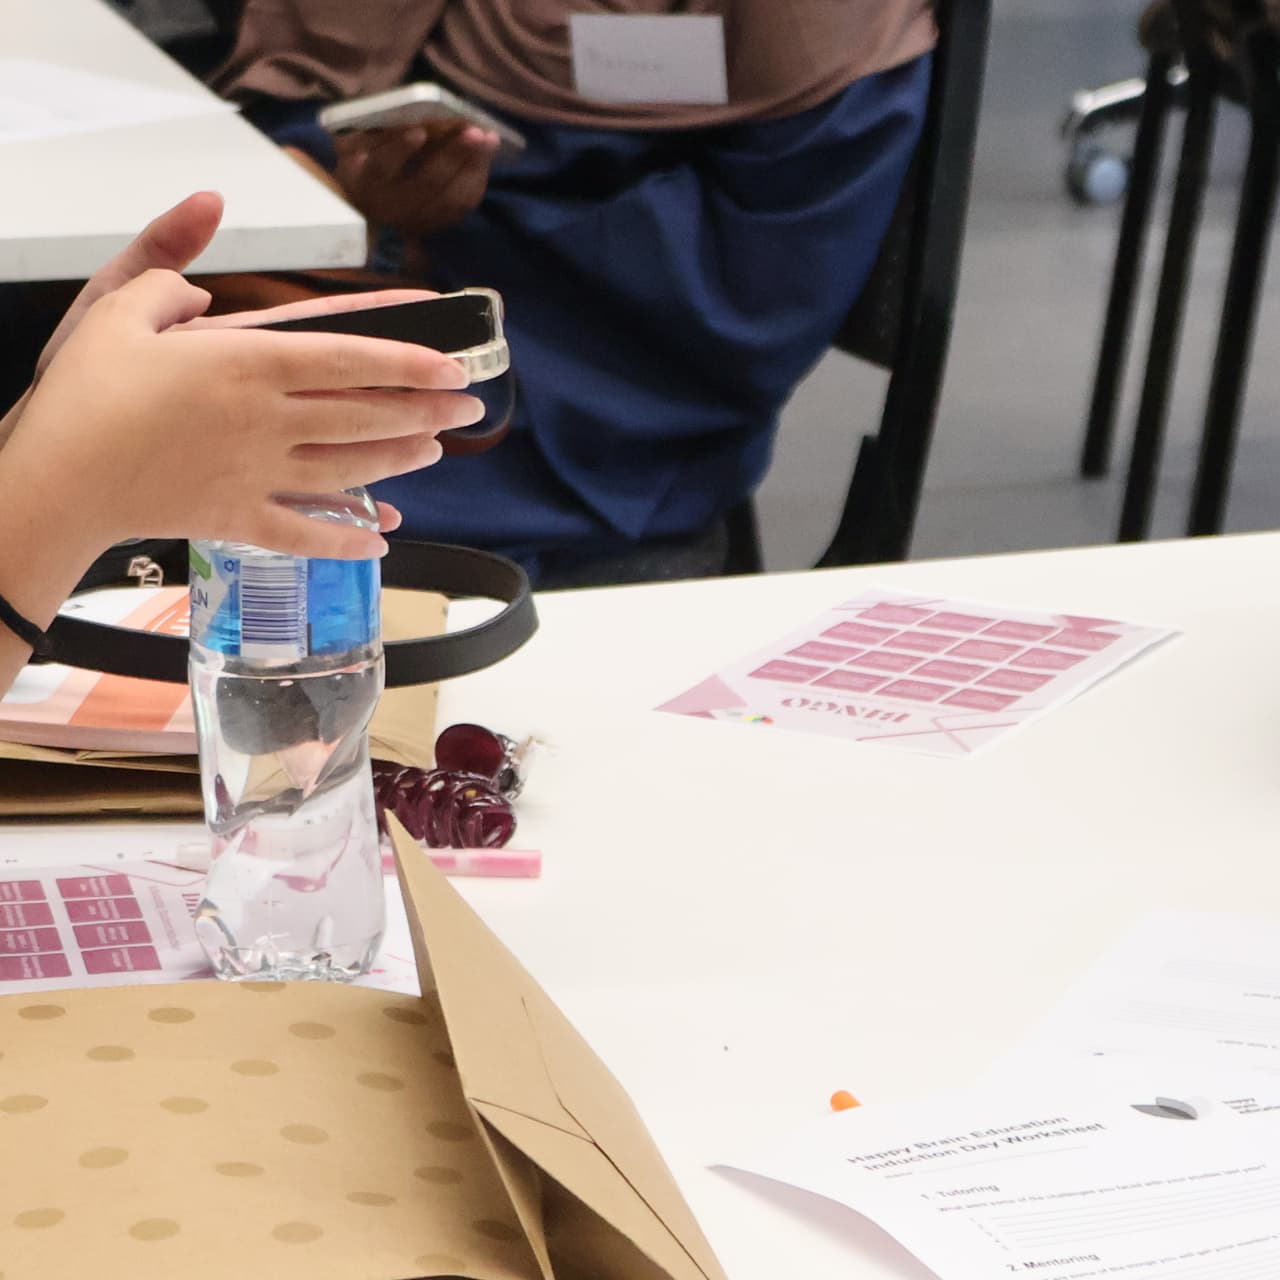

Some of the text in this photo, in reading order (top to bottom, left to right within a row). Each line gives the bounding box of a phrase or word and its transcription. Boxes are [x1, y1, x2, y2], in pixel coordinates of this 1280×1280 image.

[780, 698, 911, 723] BINGO
[847, 1116, 1070, 1164] Happy Brain Education
[863, 1122, 1107, 1171] Induction Day Worksheet
[937, 1184, 1001, 1198] Tutoring
[1023, 1253, 1101, 1269] Mentoring
